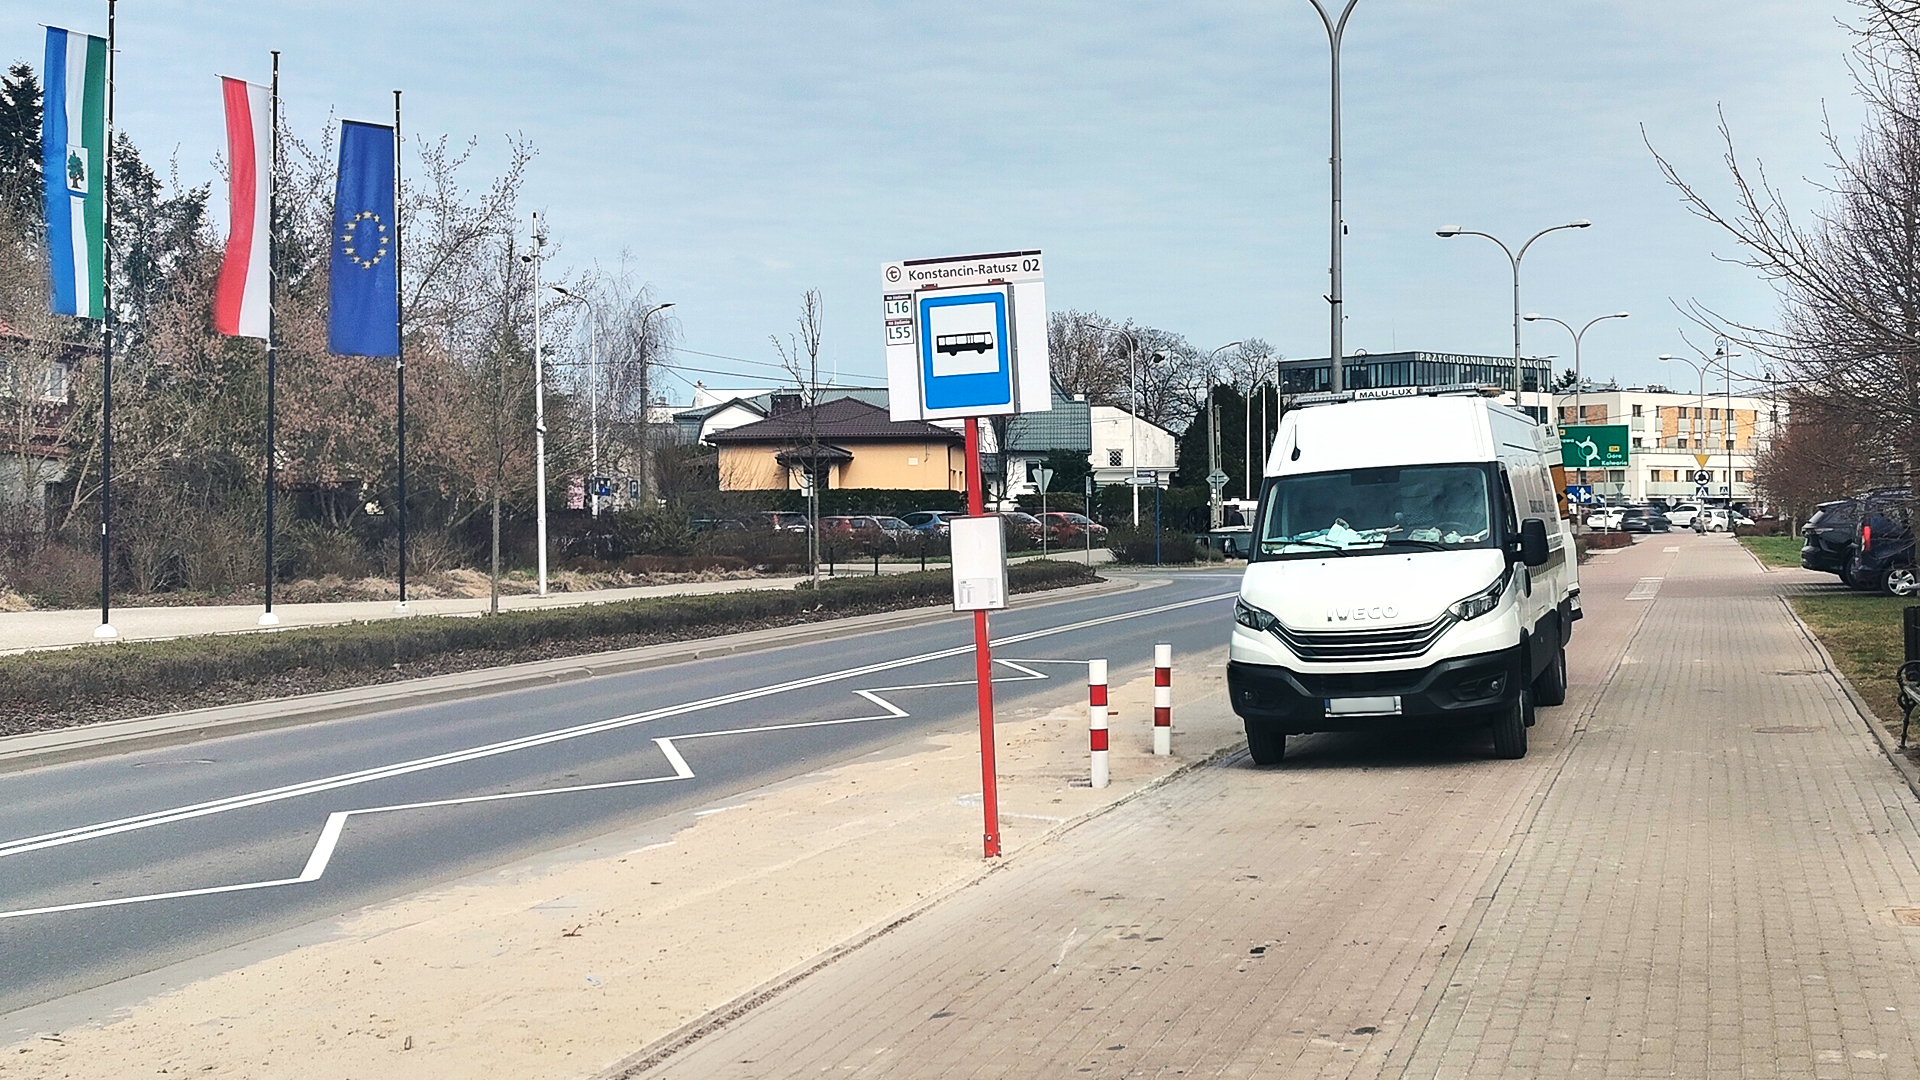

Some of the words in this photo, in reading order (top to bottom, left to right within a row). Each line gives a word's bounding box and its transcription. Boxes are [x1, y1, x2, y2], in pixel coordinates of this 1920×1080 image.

[908, 263, 1018, 282] Konstancin-Ratusz
[1022, 258, 1041, 273] 02
[887, 300, 909, 314] L16
[888, 326, 911, 340] L55
[1419, 352, 1486, 366] PRZYCHODNIA
[1492, 357, 1550, 369] KONSANCIN
[1359, 388, 1413, 399] MALU-LUX
[1326, 606, 1400, 622] IVECO
